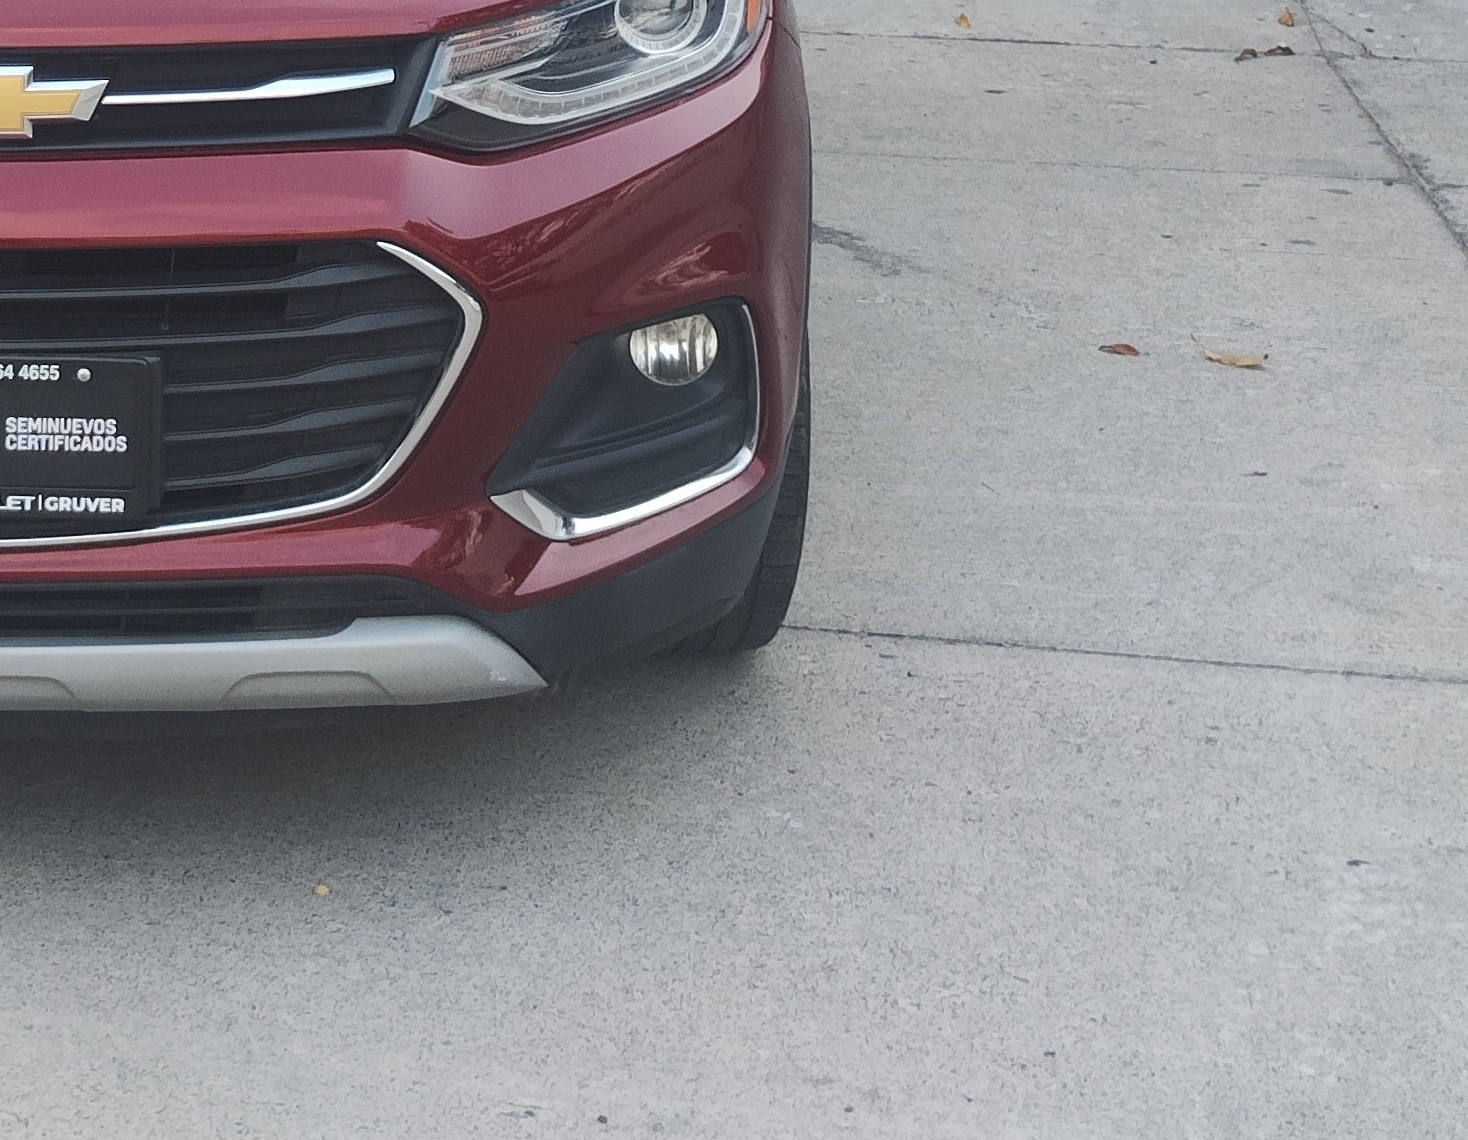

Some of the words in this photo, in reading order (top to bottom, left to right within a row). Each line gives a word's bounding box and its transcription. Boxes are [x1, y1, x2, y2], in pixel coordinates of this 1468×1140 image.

[18, 364, 60, 381] 4655
[5, 416, 117, 436] SEMINUEVOS
[5, 434, 128, 453] CERTIFICADOS
[44, 496, 125, 513] GRUVER
